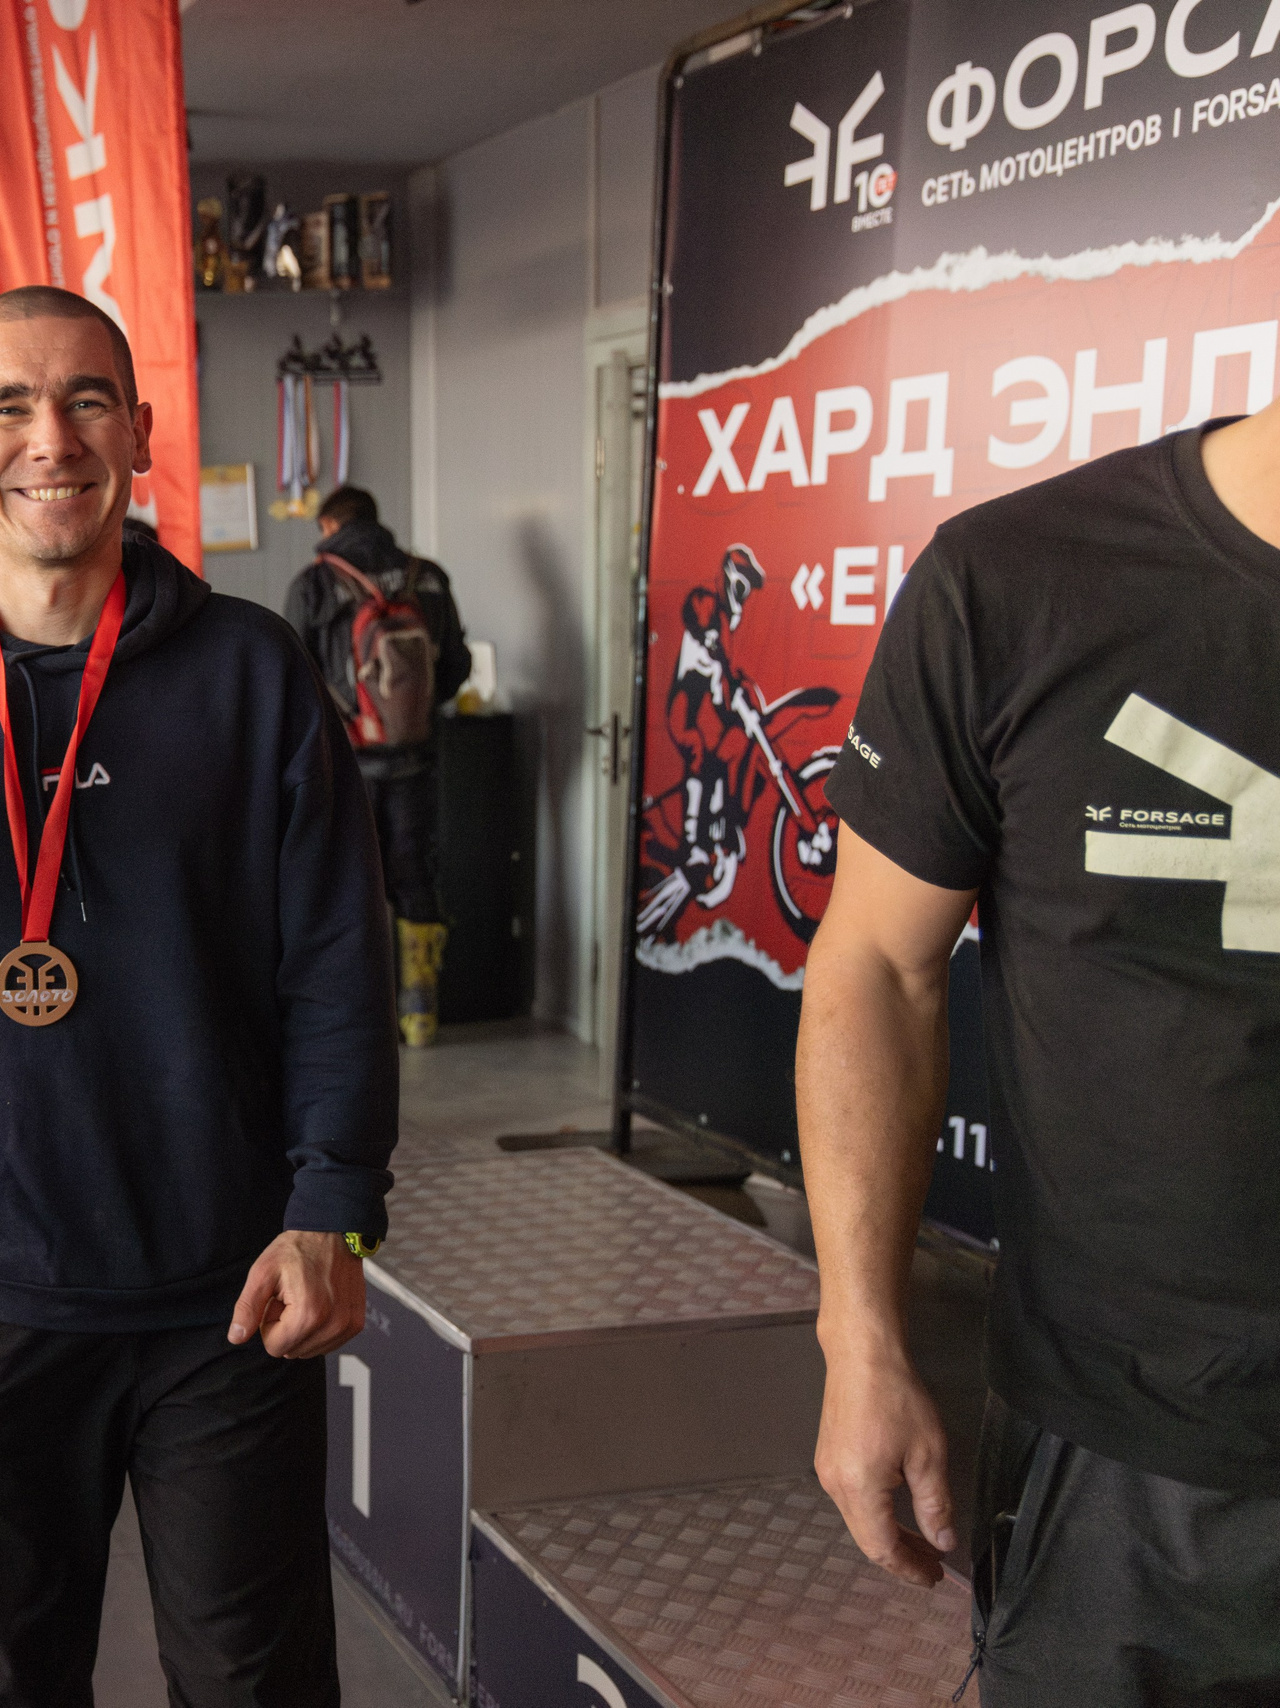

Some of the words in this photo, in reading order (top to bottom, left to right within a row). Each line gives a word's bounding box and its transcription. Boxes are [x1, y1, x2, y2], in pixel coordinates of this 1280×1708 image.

[921, 169, 976, 207] СЕТЬ
[980, 114, 1161, 192] МОТОЦЕНТРОВ
[693, 371, 955, 501] ХАРД
[40, 762, 111, 791] FLA
[847, 722, 882, 769] SAGE
[1120, 809, 1225, 826] FORSAGE
[338, 1354, 371, 1520] 1
